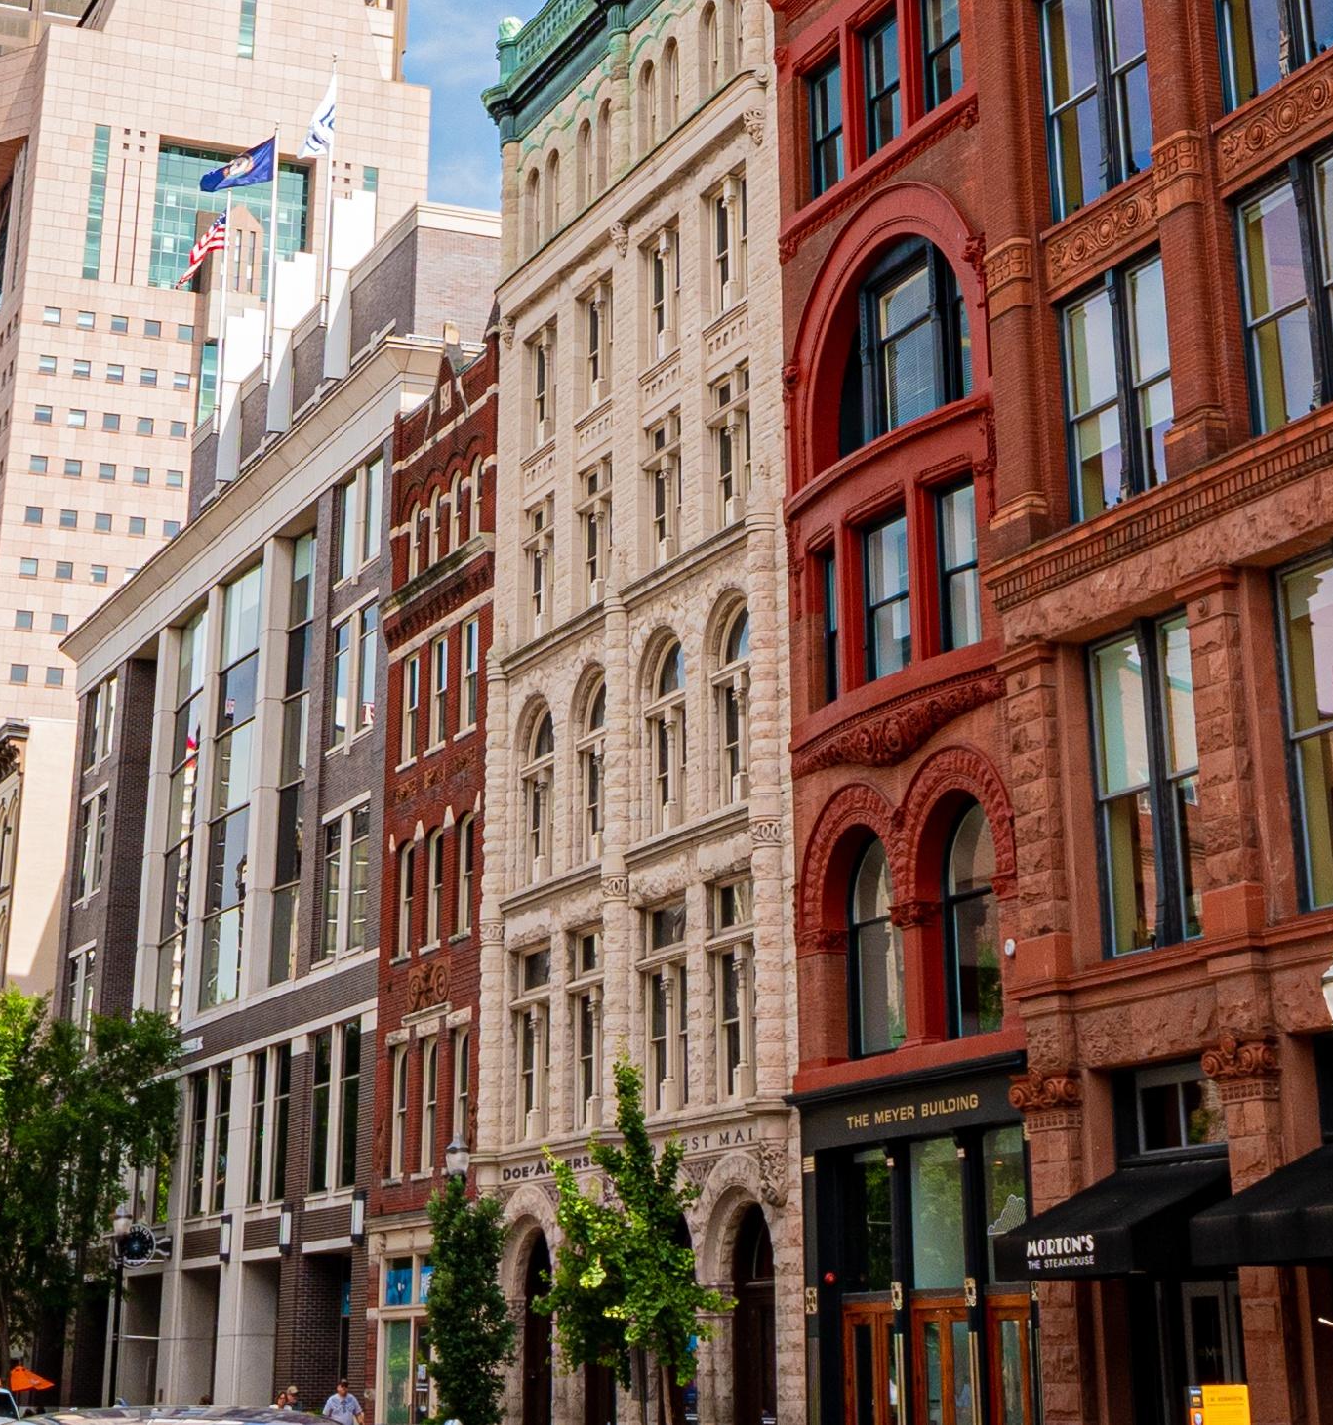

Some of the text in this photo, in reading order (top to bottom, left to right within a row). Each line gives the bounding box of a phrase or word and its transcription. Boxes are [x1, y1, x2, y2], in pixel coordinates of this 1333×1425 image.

[846, 1094, 979, 1130] THE MEYER BUILDING
[1026, 1234, 1095, 1258] MORTON'S
[1028, 1254, 1095, 1270] THE STEAKHOUSE
